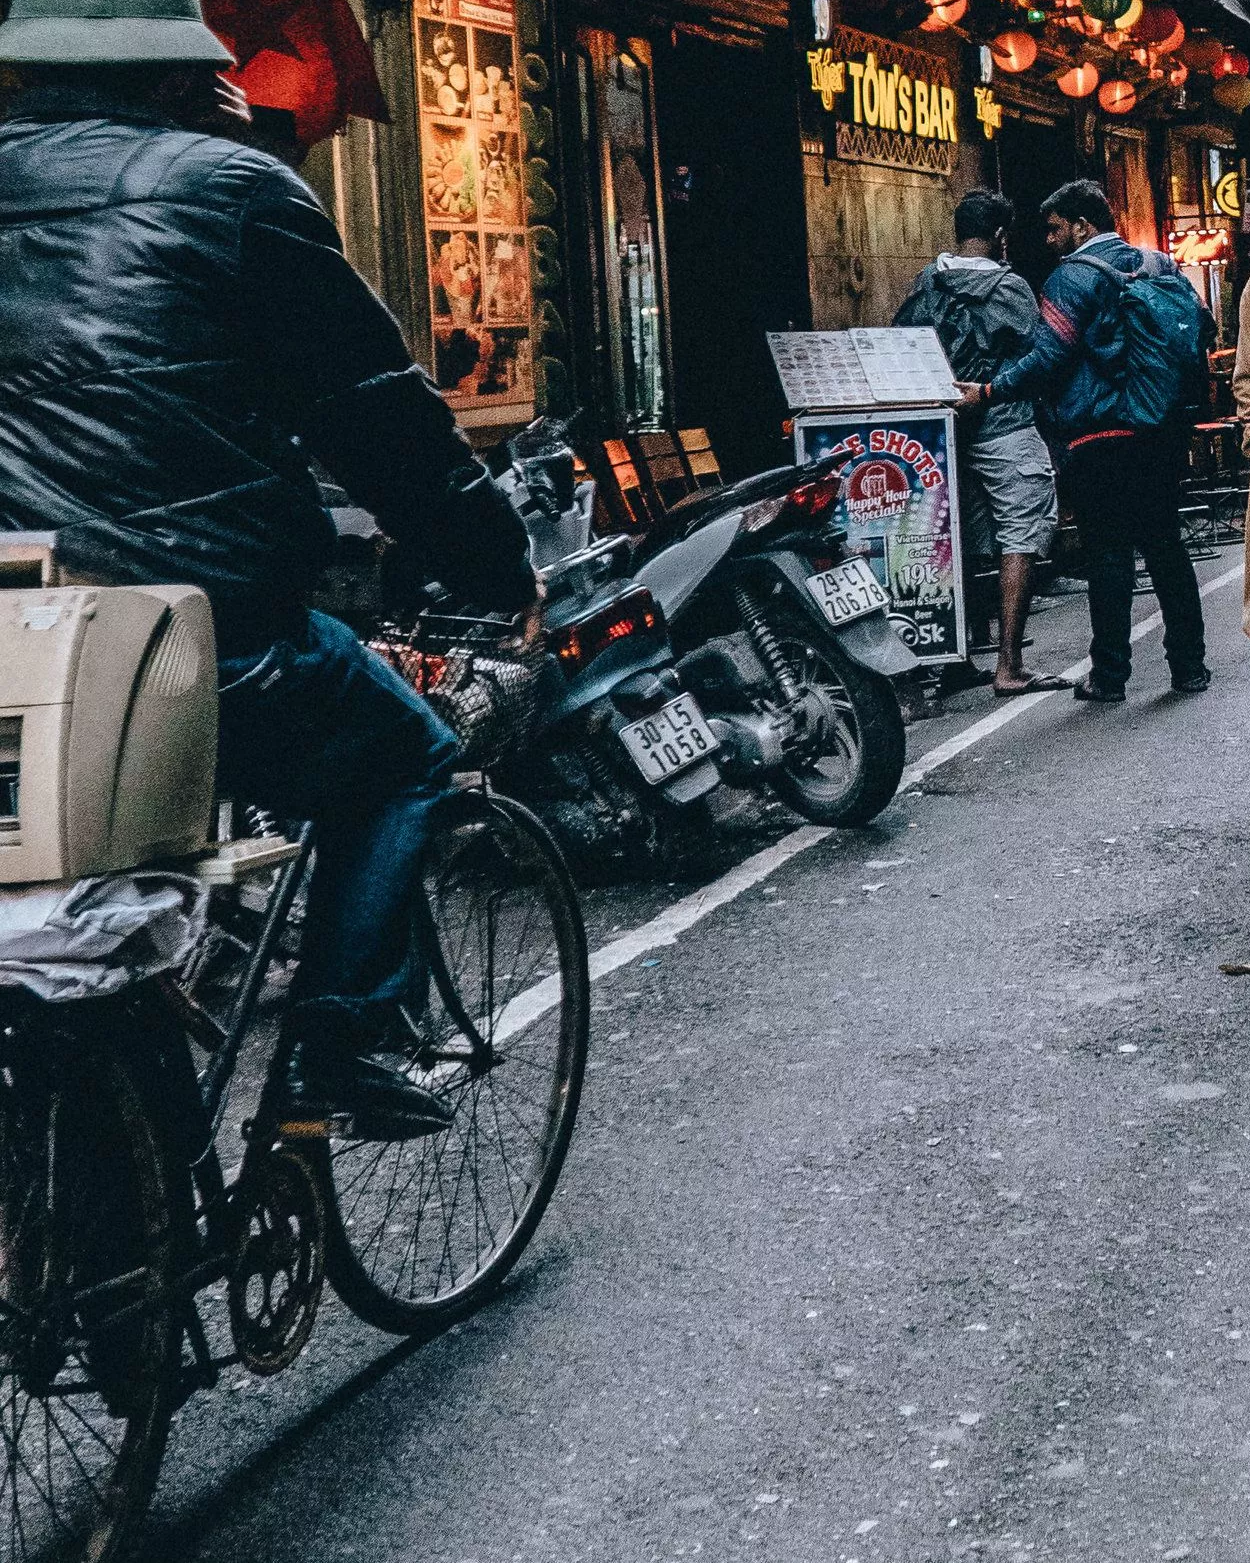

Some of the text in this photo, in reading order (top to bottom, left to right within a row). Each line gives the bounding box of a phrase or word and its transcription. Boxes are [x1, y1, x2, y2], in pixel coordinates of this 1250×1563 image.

[807, 48, 845, 111] Tiger
[914, 79, 958, 143] BAR
[974, 87, 1002, 140] Tiger
[870, 430, 944, 489] SHOTS
[845, 489, 912, 512] Happy Hour
[853, 502, 906, 524] Specials!
[896, 533, 948, 544] Vietnamese
[908, 547, 938, 558] Coffee
[816, 563, 866, 598] 29-C1
[901, 563, 939, 585] 19k
[824, 583, 885, 621] 206.78
[633, 703, 693, 751] 30-L5
[649, 728, 707, 774] 1058
